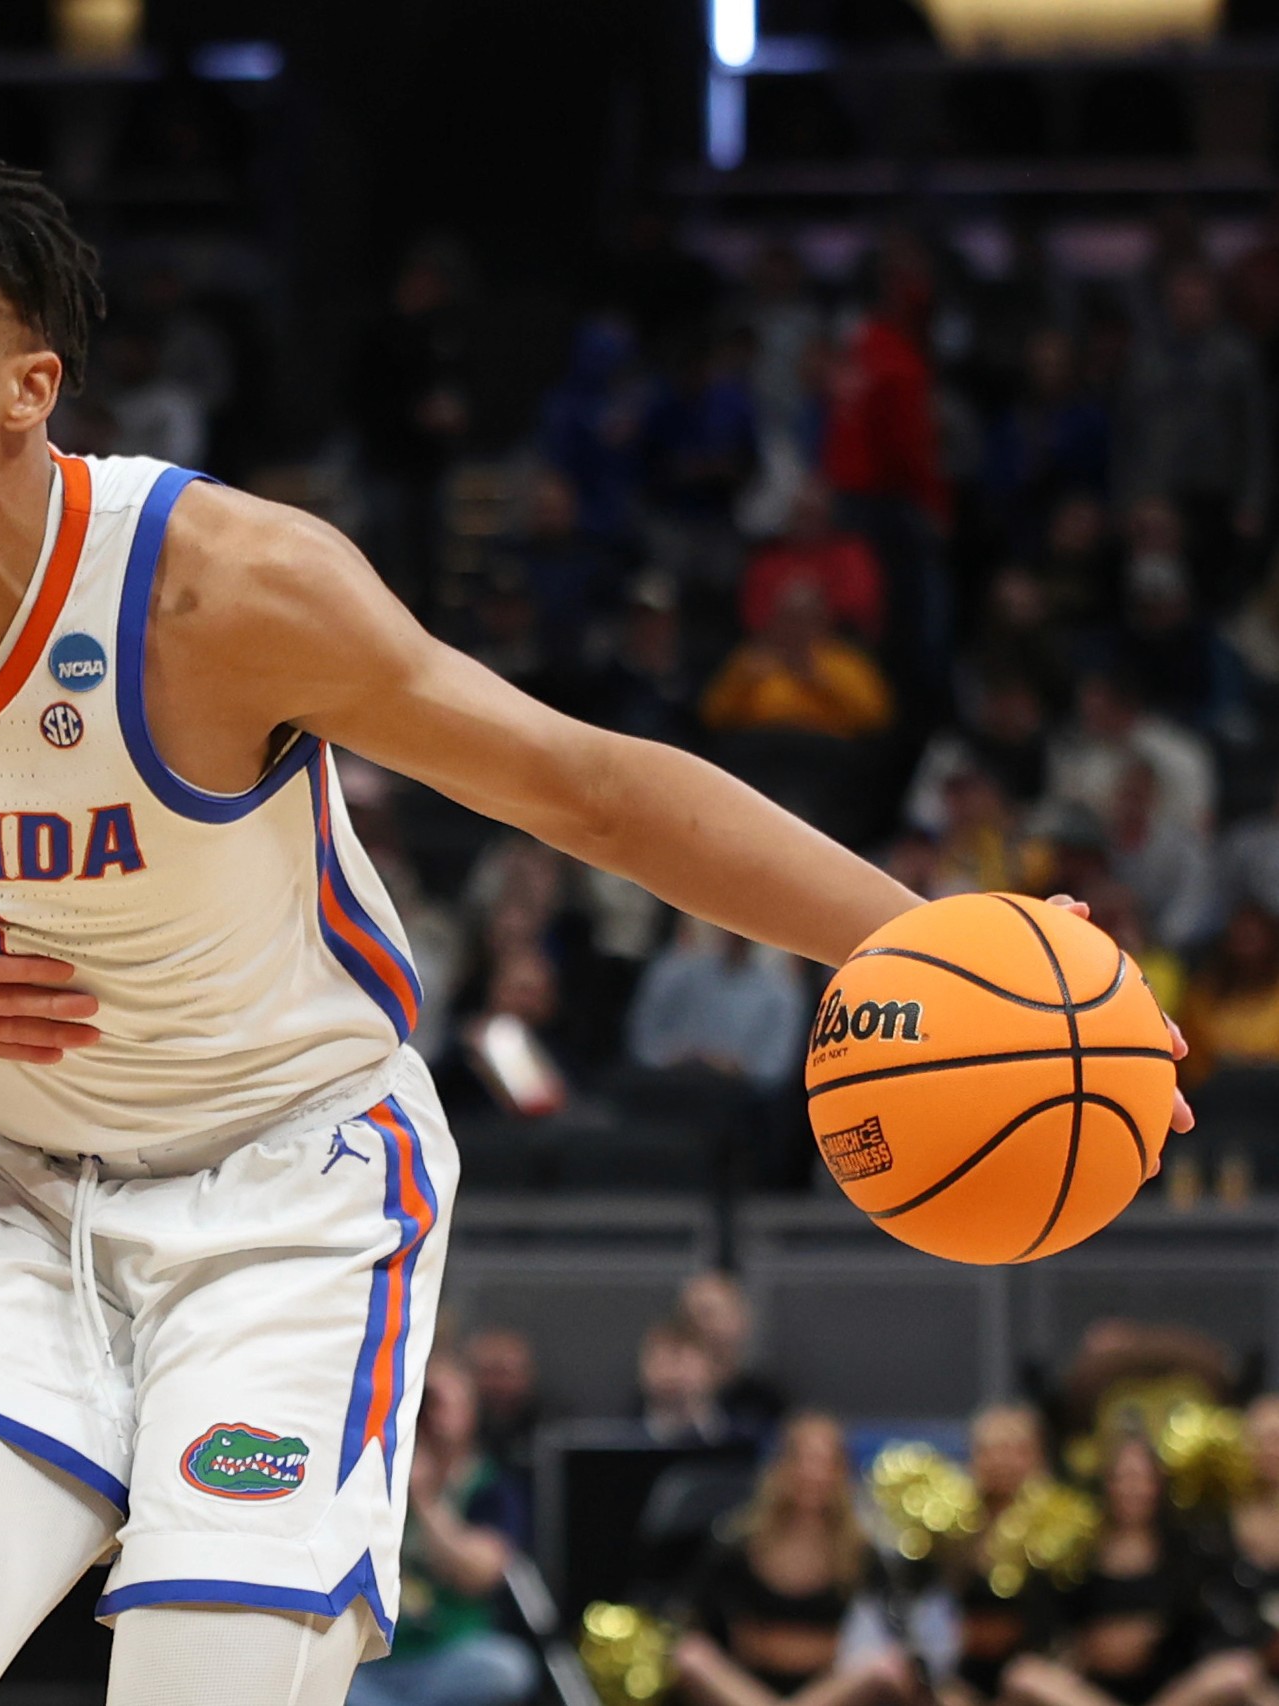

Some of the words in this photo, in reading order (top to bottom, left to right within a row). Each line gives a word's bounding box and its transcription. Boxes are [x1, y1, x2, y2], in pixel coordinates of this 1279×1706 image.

[58, 660, 104, 679] NCAA
[43, 705, 81, 746] SEC
[811, 987, 922, 1053] ilson
[824, 1130, 861, 1155] MARCH
[836, 1142, 891, 1174] MADNESS
